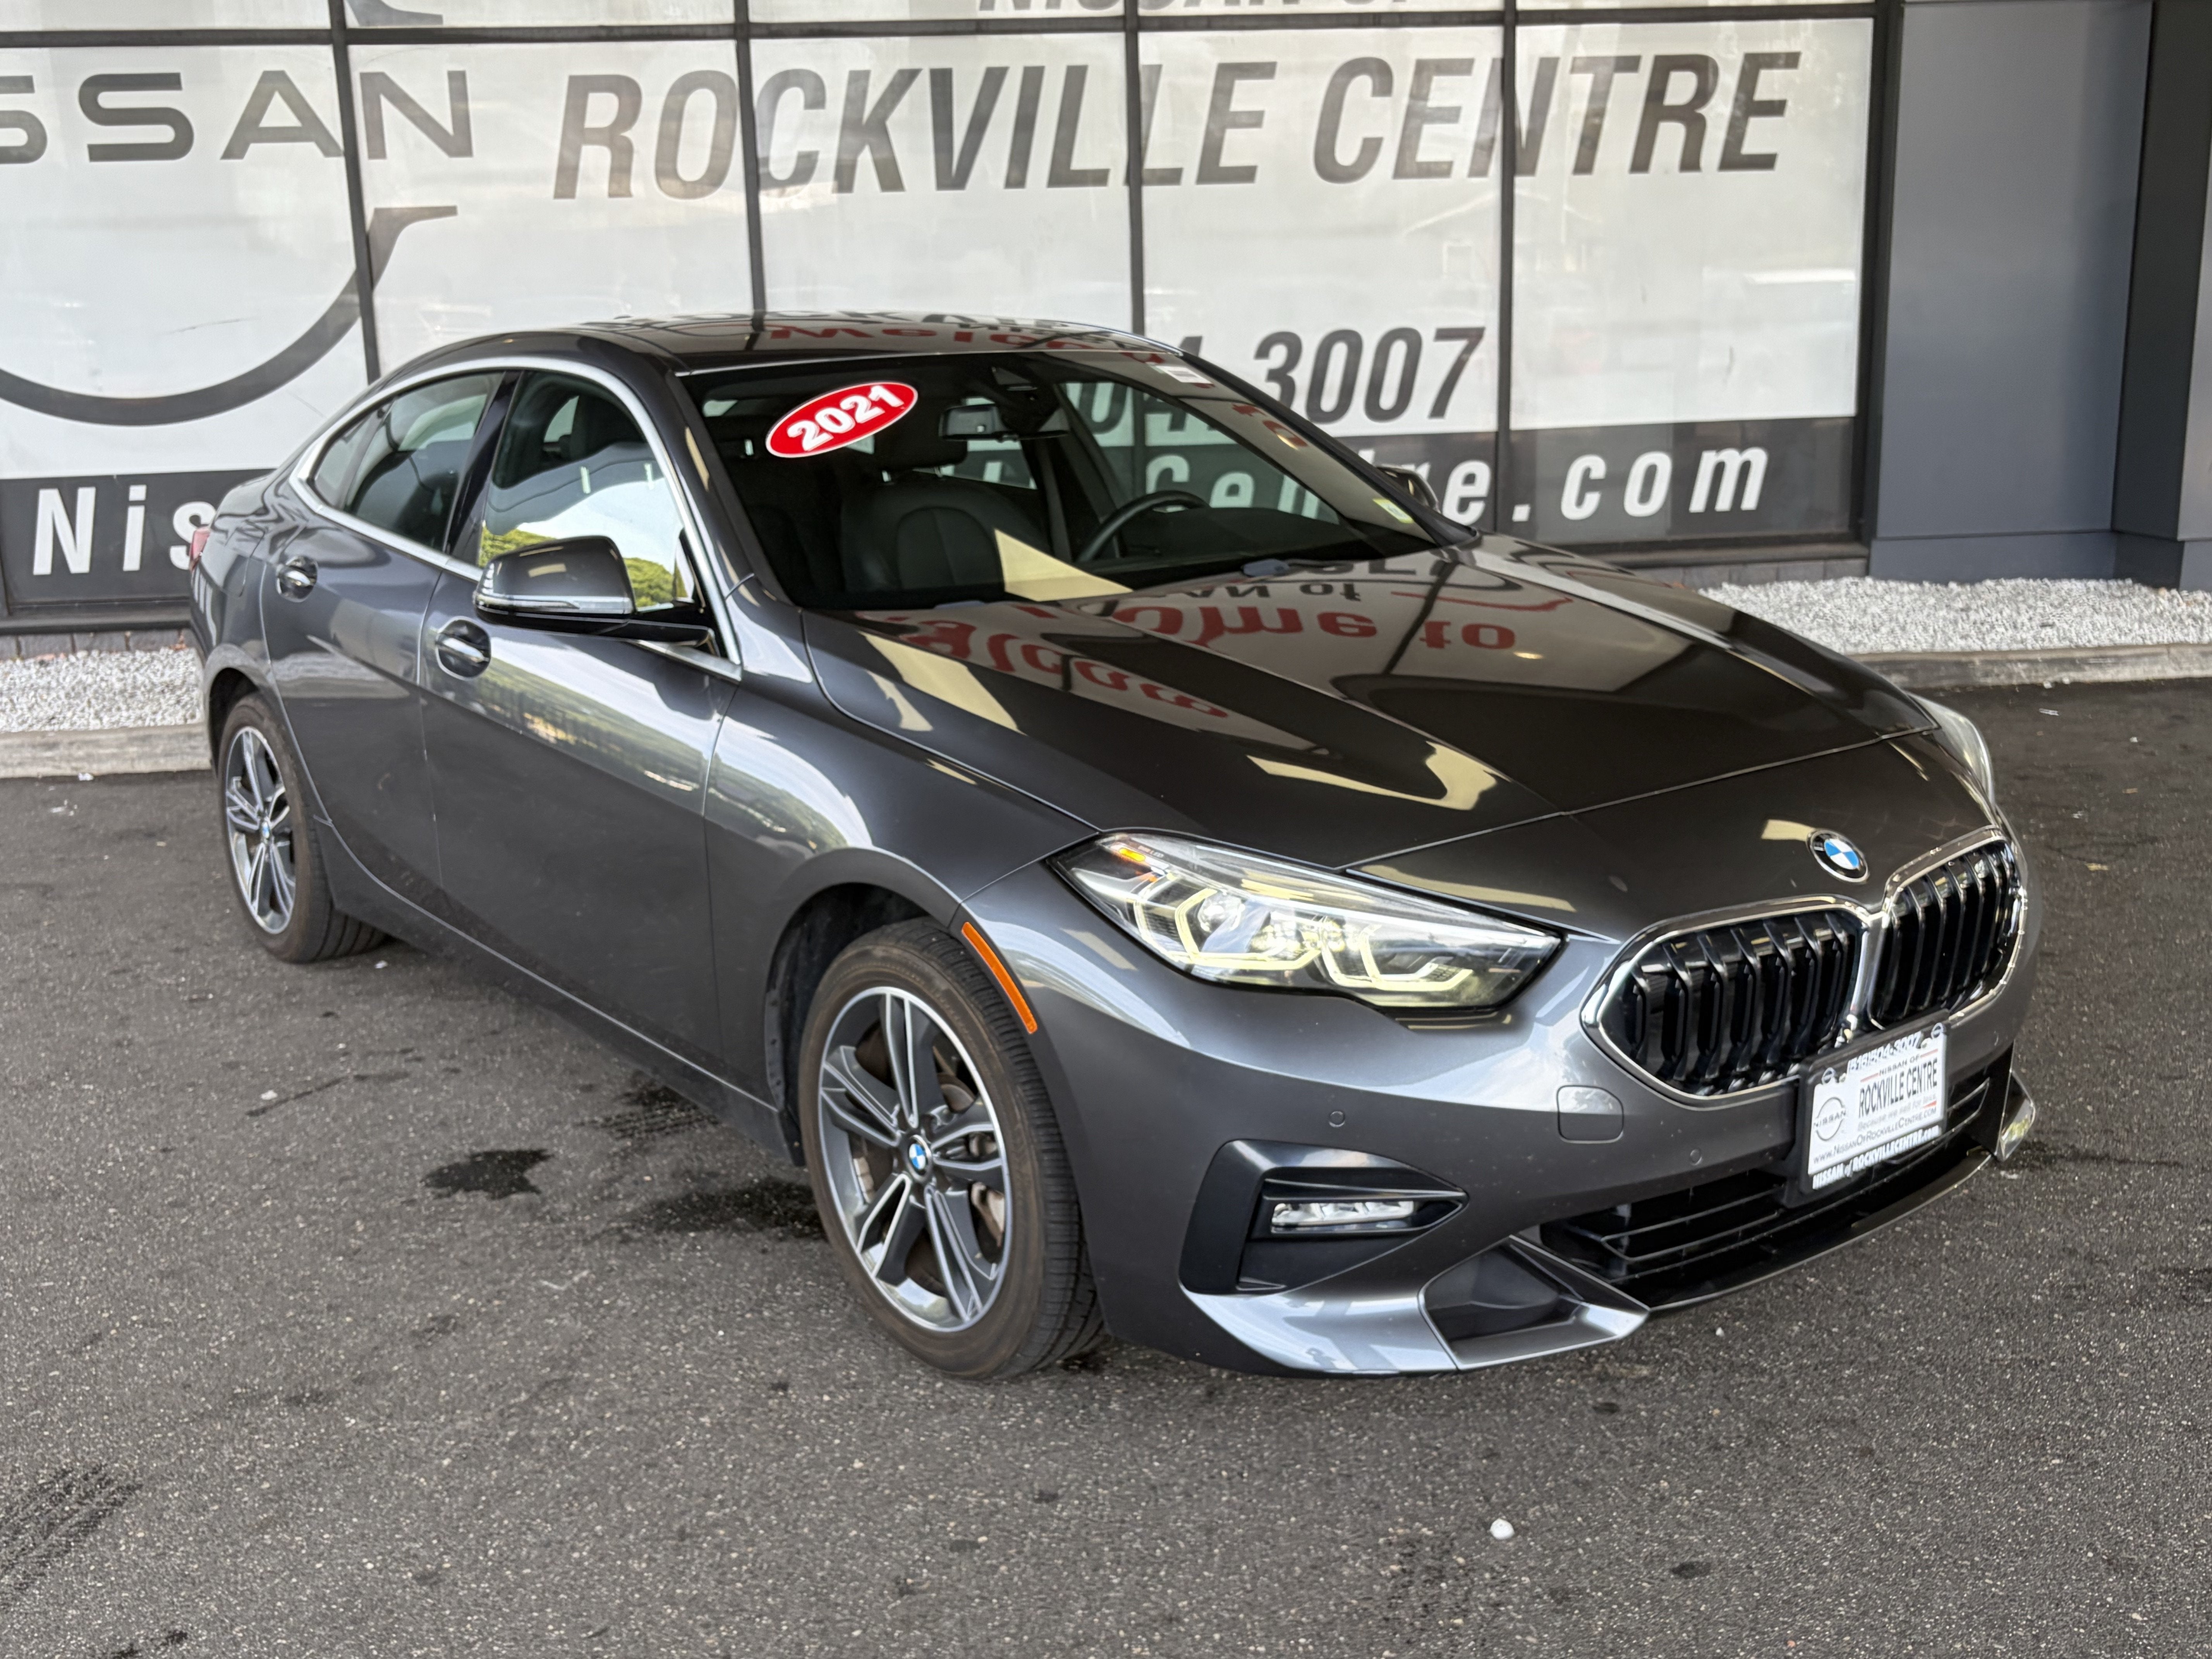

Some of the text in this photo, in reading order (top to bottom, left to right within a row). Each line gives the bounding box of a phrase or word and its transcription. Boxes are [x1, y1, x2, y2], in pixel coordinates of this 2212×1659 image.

[553, 61, 1278, 200] ROCKVILLE
[1313, 51, 1802, 184] CENTRE
[787, 385, 905, 452] 2021
[1401, 447, 1768, 526] e.com
[1858, 1056, 1937, 1118] ROCKVILLE CENTRE
[1879, 1058, 1908, 1076] NISSAN
[1814, 1110, 1846, 1128] NISSAN
